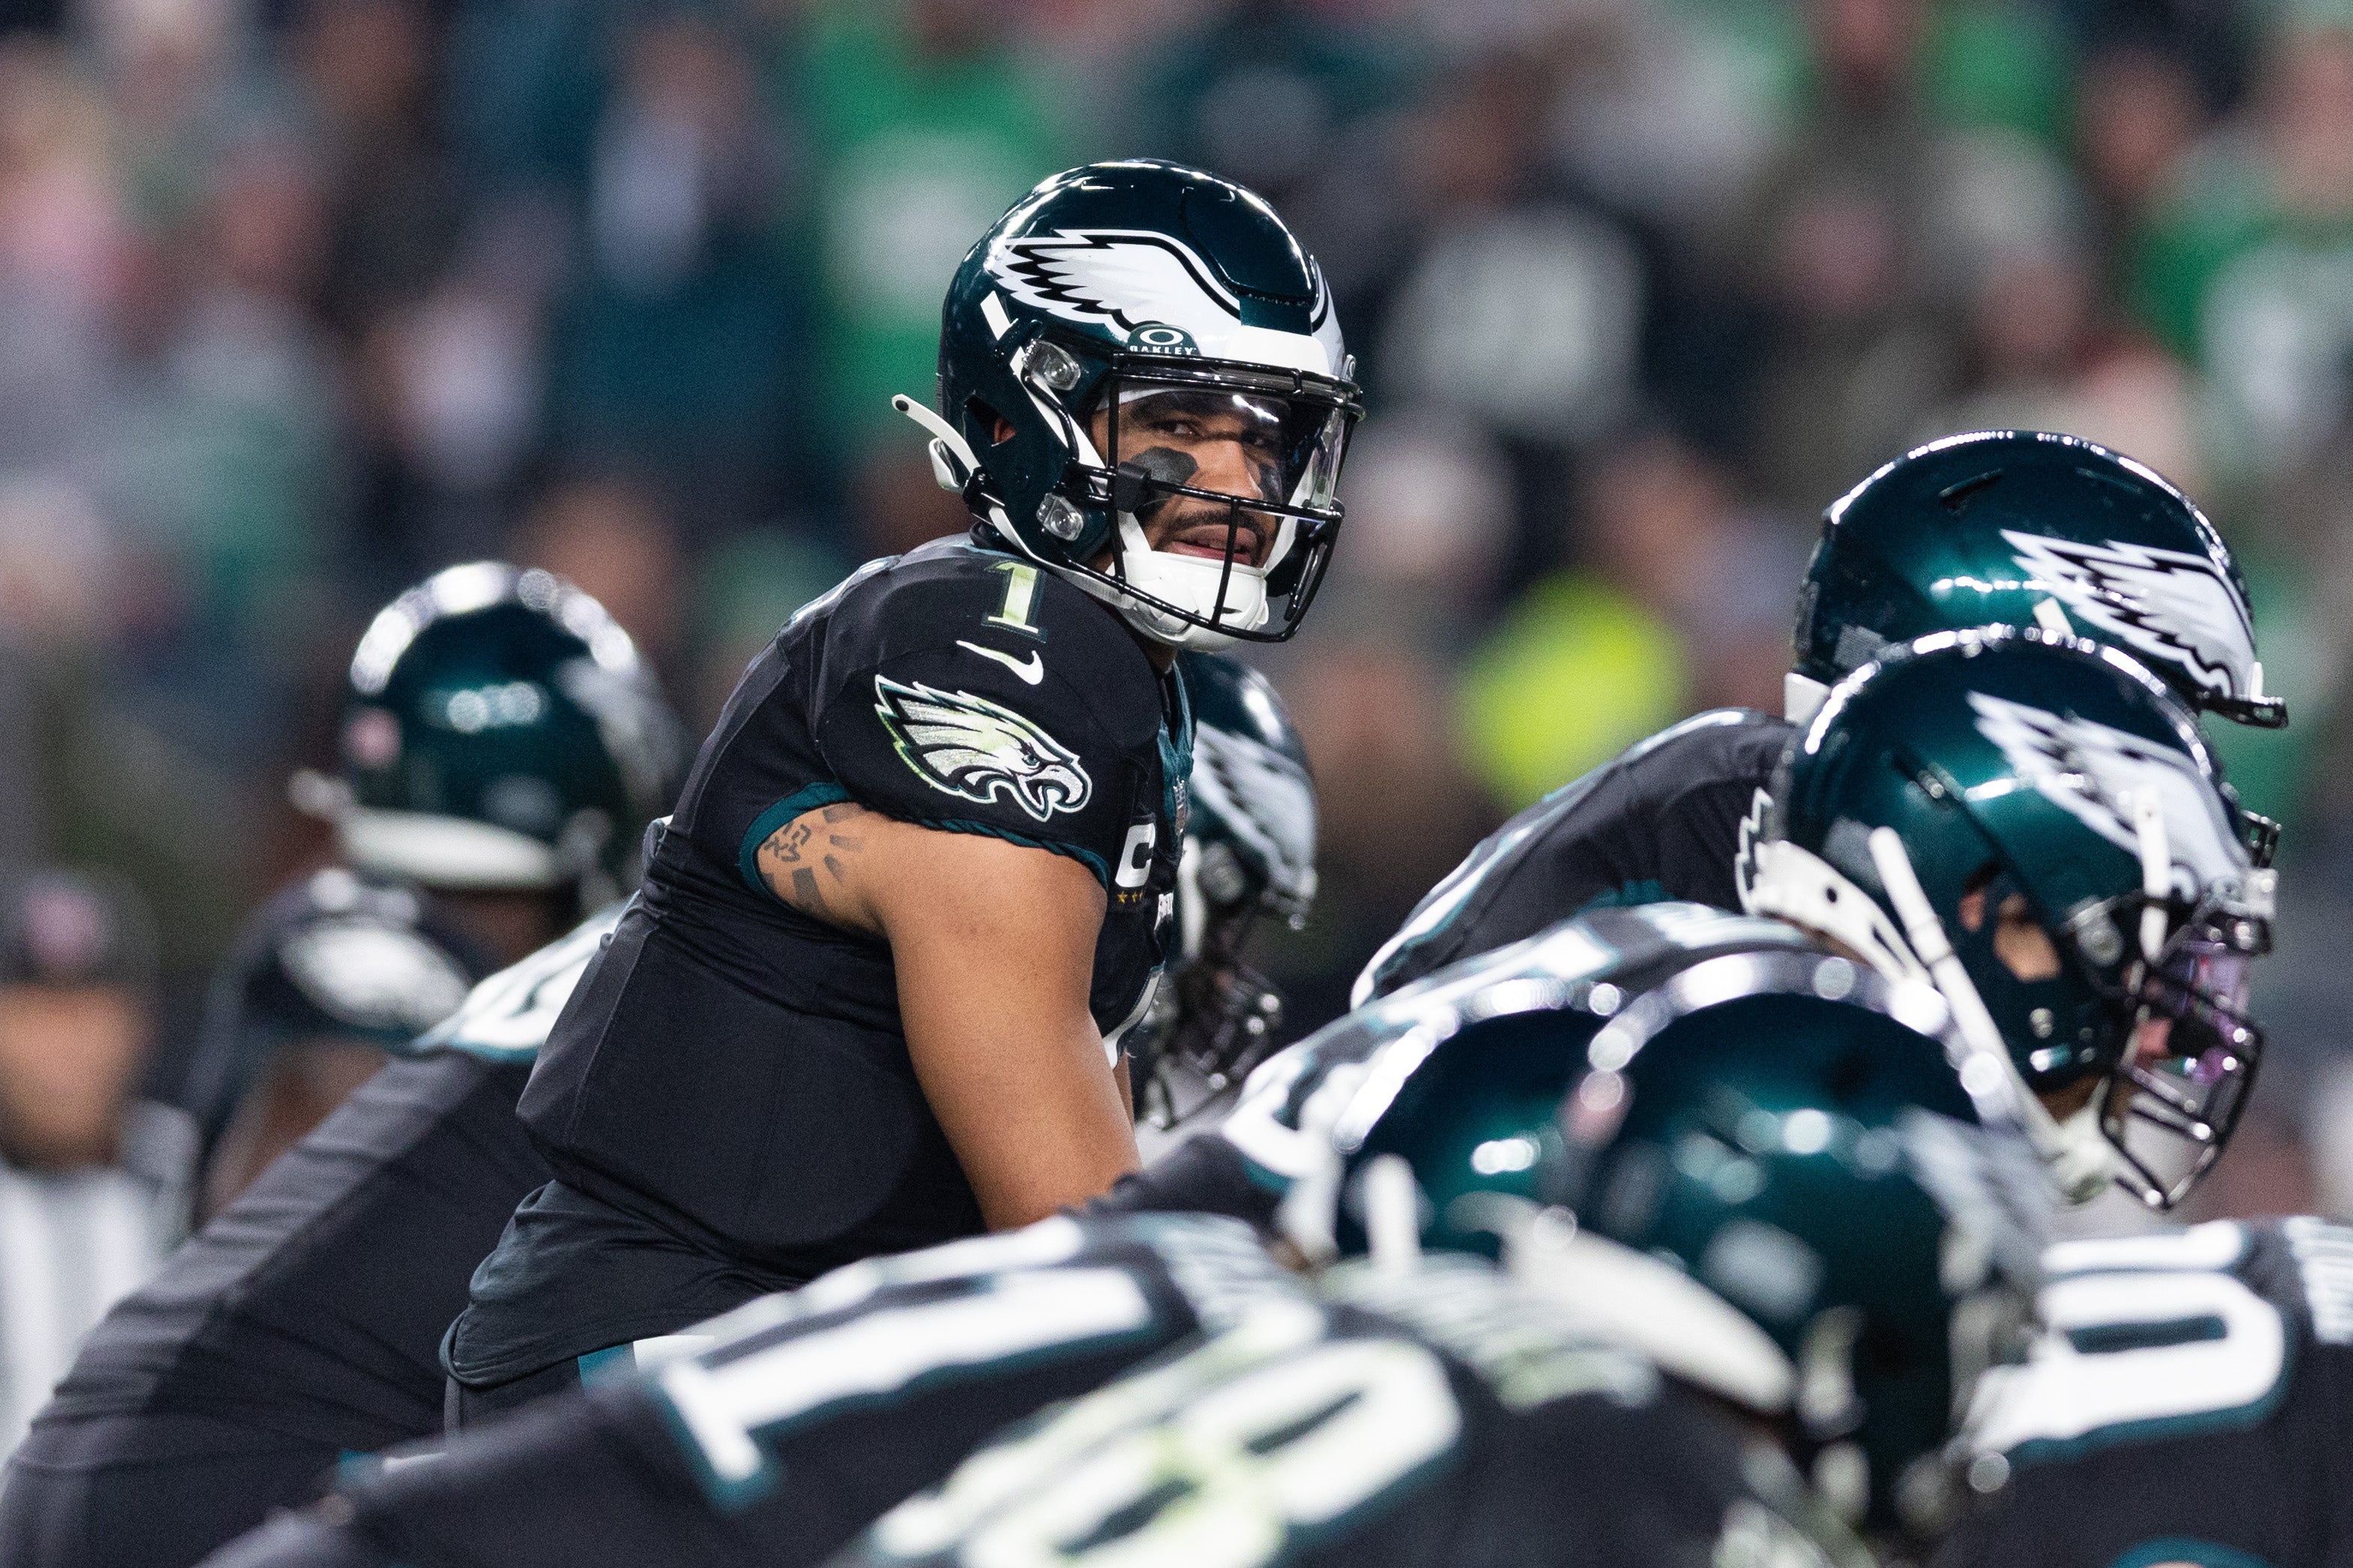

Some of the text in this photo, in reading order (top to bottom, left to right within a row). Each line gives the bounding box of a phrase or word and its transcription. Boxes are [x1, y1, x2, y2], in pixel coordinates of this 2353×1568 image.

[1129, 345, 1196, 355] OAKLEY
[987, 561, 1041, 637] 1
[1115, 823, 1155, 887] C
